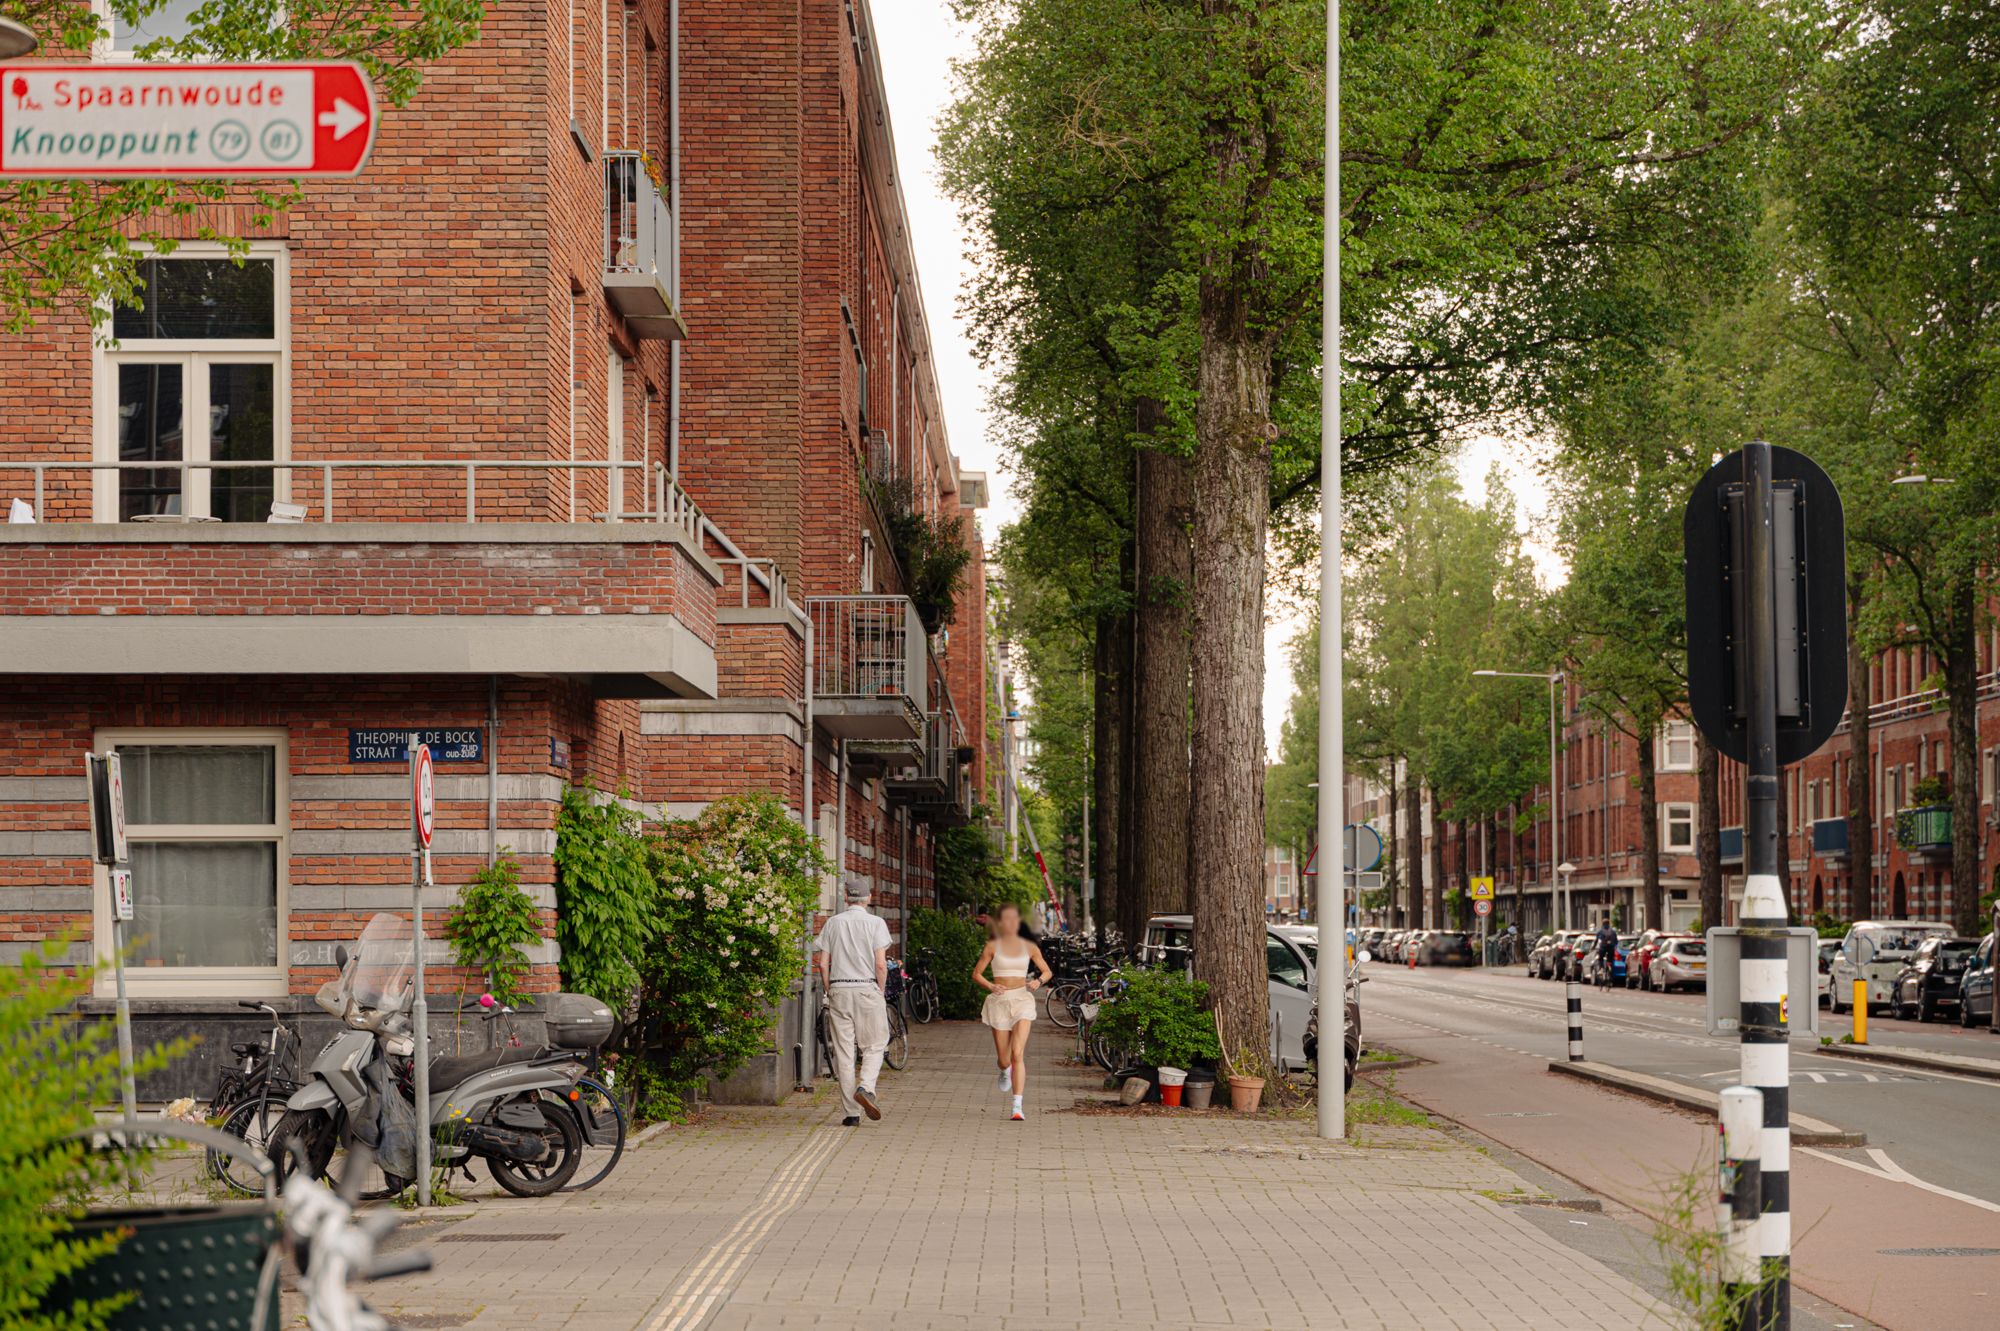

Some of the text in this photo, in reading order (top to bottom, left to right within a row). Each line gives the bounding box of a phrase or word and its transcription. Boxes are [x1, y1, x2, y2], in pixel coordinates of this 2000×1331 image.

[54, 80, 285, 111] Spaarnwoude
[11, 126, 293, 159] Knooppunt 79 81
[356, 731, 476, 744] THEOPHIE DE BOCK
[355, 746, 397, 759] STRAAT
[445, 750, 476, 758] OUD-ZUID
